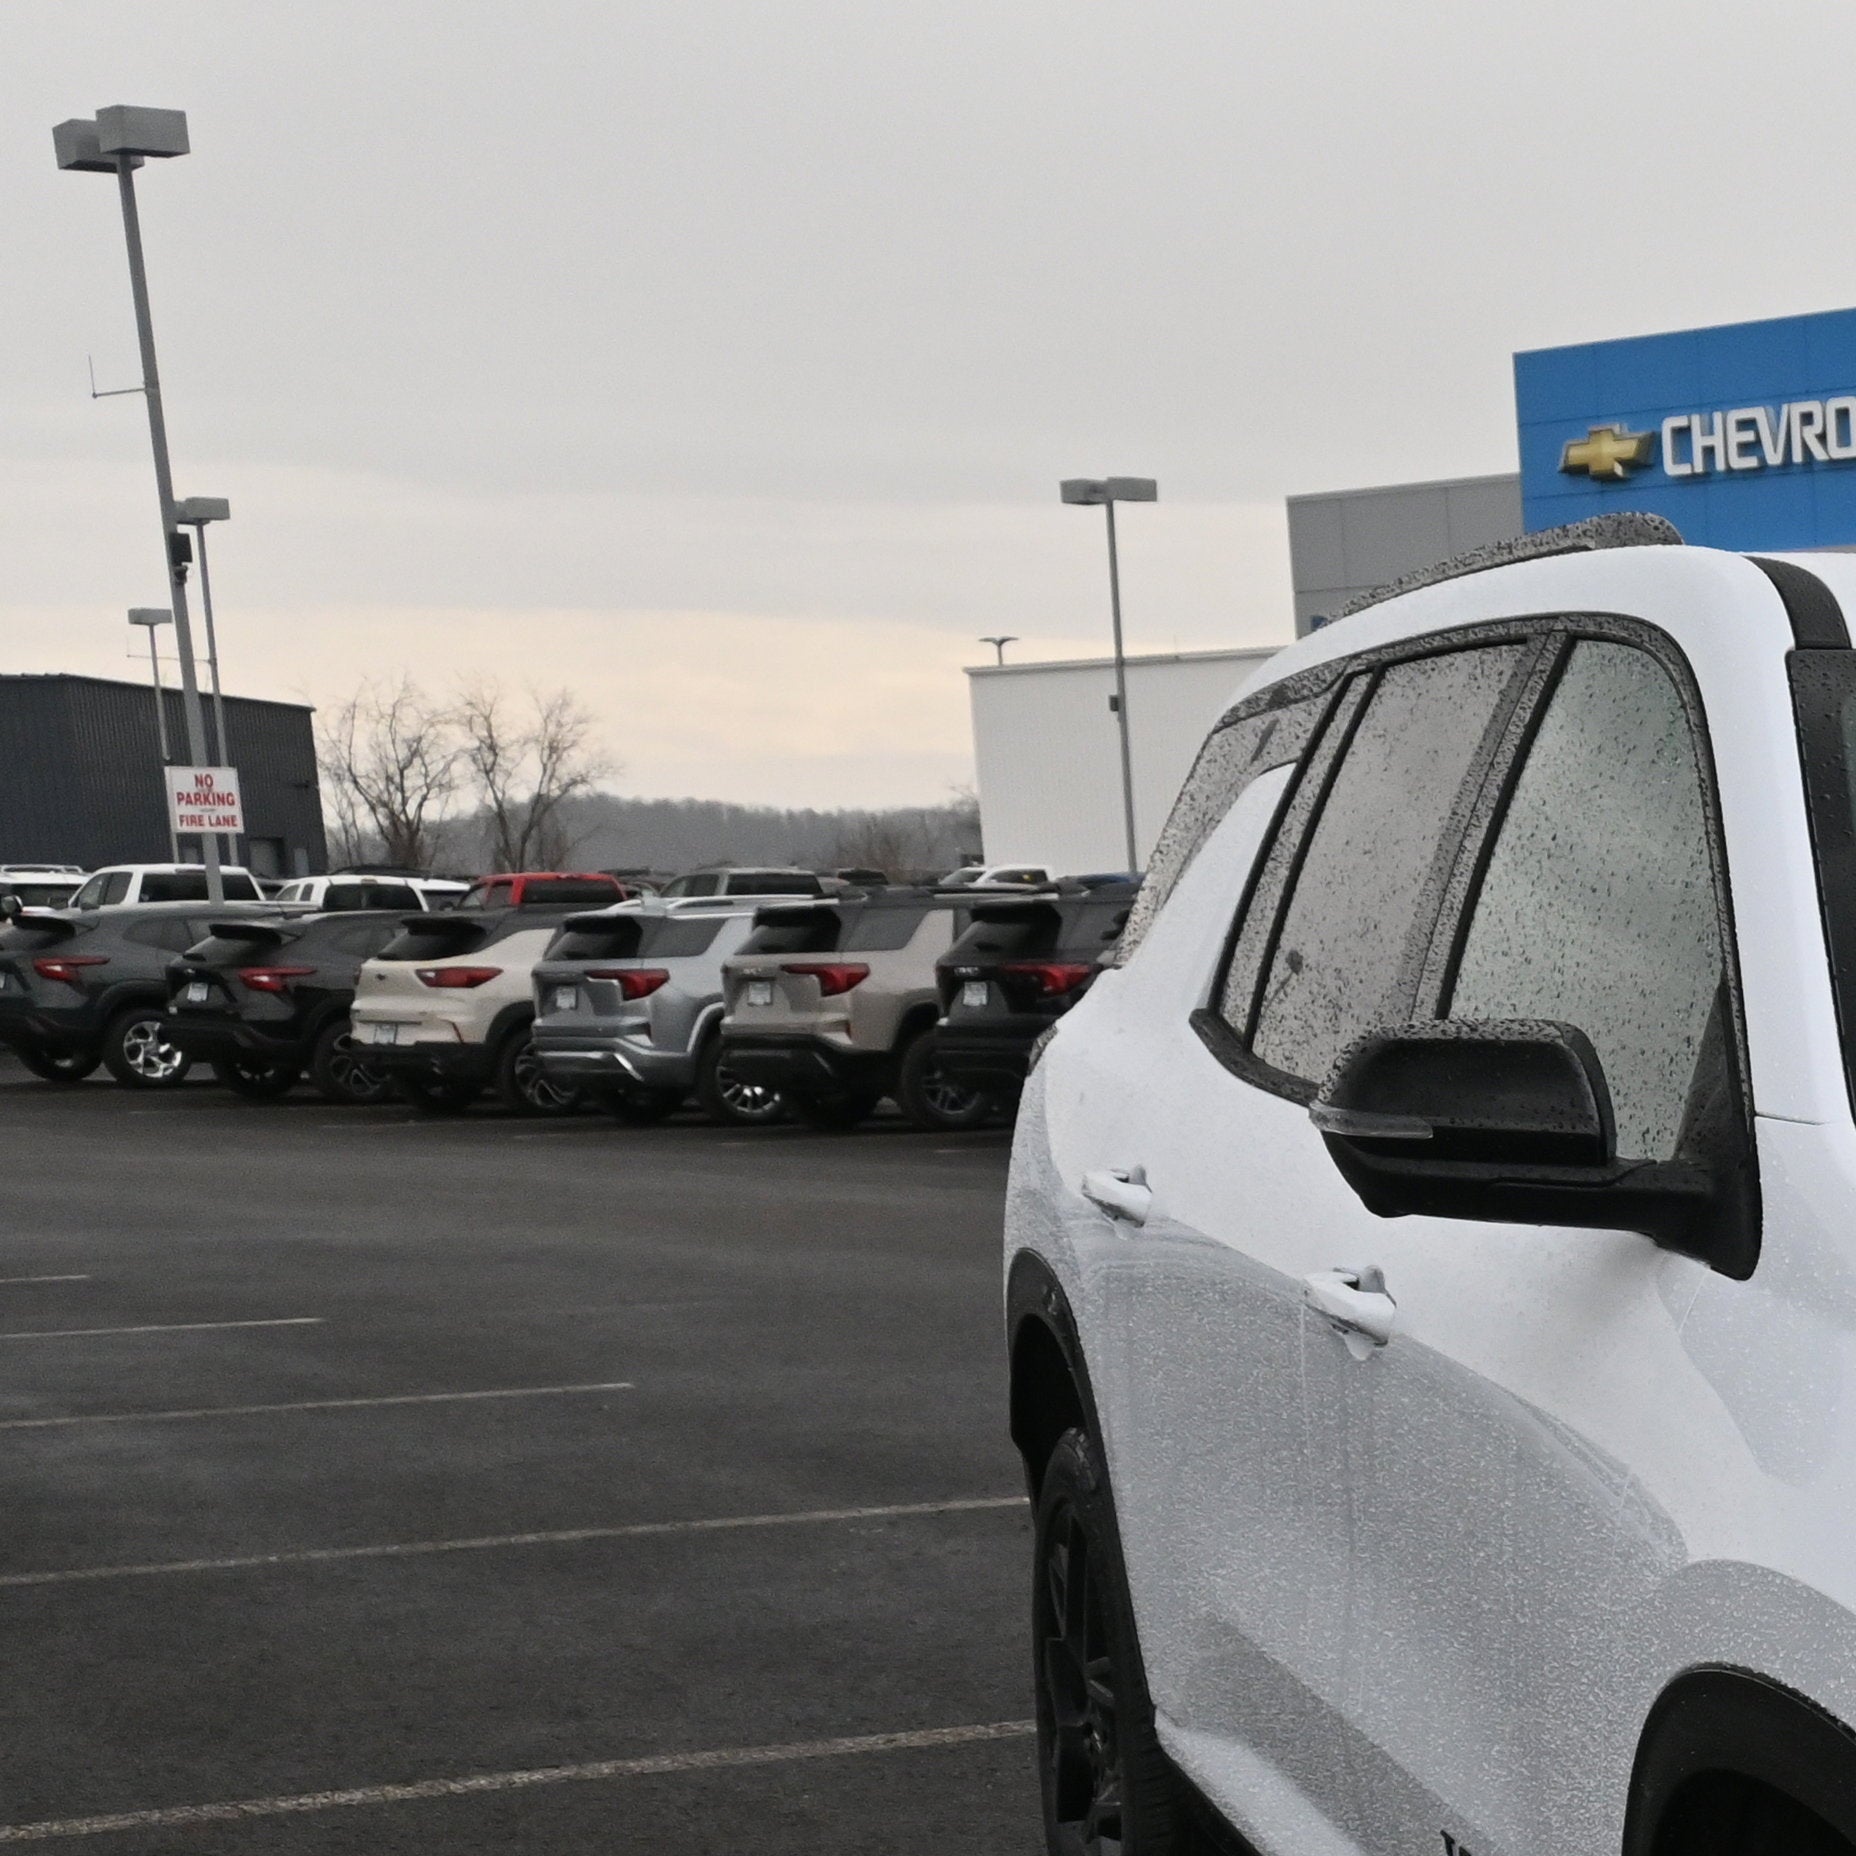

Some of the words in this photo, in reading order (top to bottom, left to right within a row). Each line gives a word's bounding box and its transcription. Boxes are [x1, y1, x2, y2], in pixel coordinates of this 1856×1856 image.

[194, 773, 214, 788] NO
[176, 791, 236, 806] PARKING
[179, 814, 205, 827] FIRE
[208, 815, 238, 827] LANE
